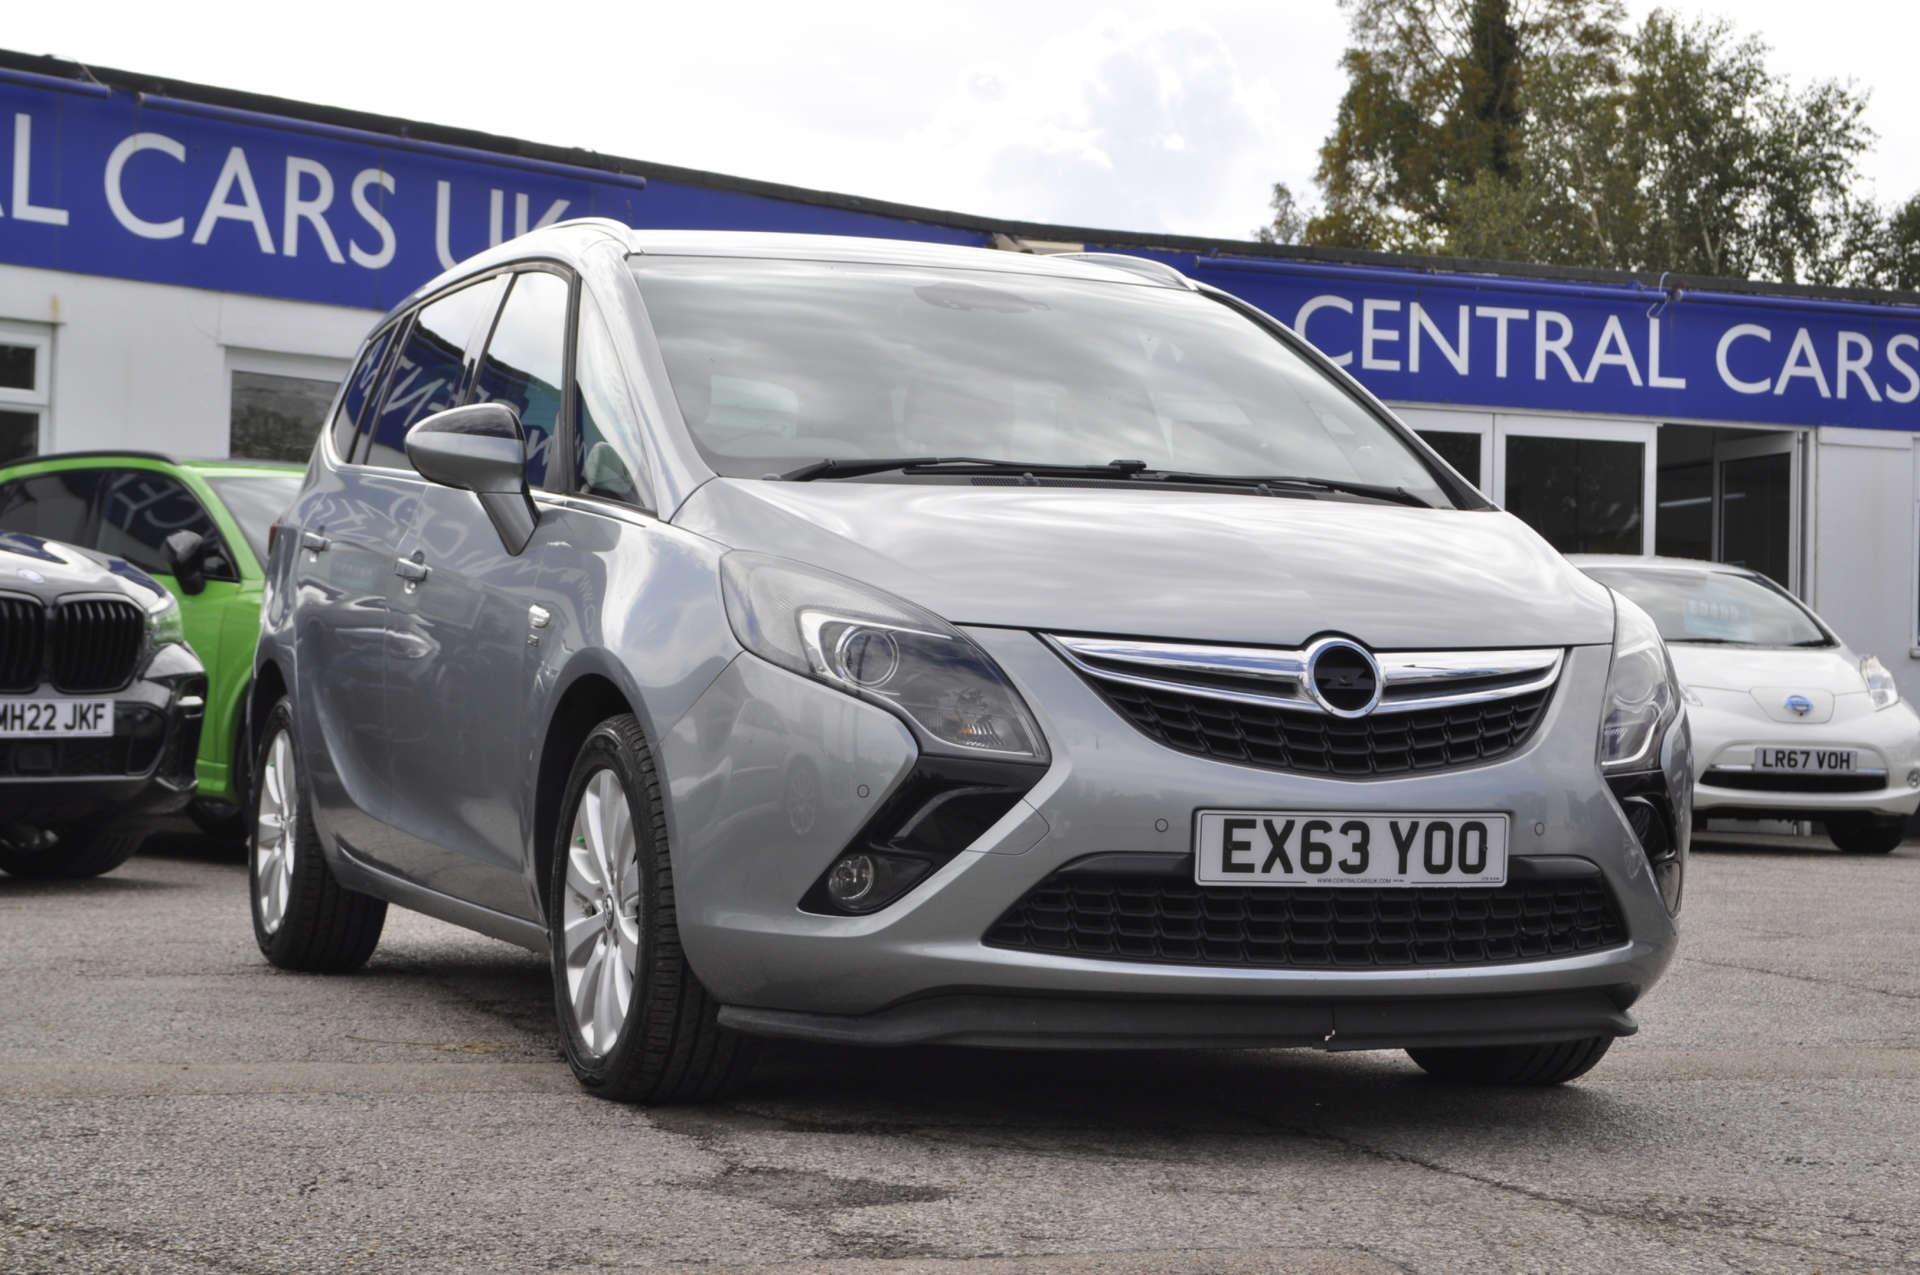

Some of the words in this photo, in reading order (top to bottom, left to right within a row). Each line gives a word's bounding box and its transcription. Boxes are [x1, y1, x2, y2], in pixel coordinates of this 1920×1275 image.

[0, 113, 69, 226] L
[104, 132, 396, 270] CARS
[1294, 294, 1686, 389] CENTRAL
[1716, 324, 1920, 403] CARS
[64, 703, 105, 731] JKF
[1762, 750, 1810, 768] LR67
[1817, 752, 1850, 770] VOH
[1222, 819, 1370, 874] EX63
[1390, 821, 1488, 875] YOO
